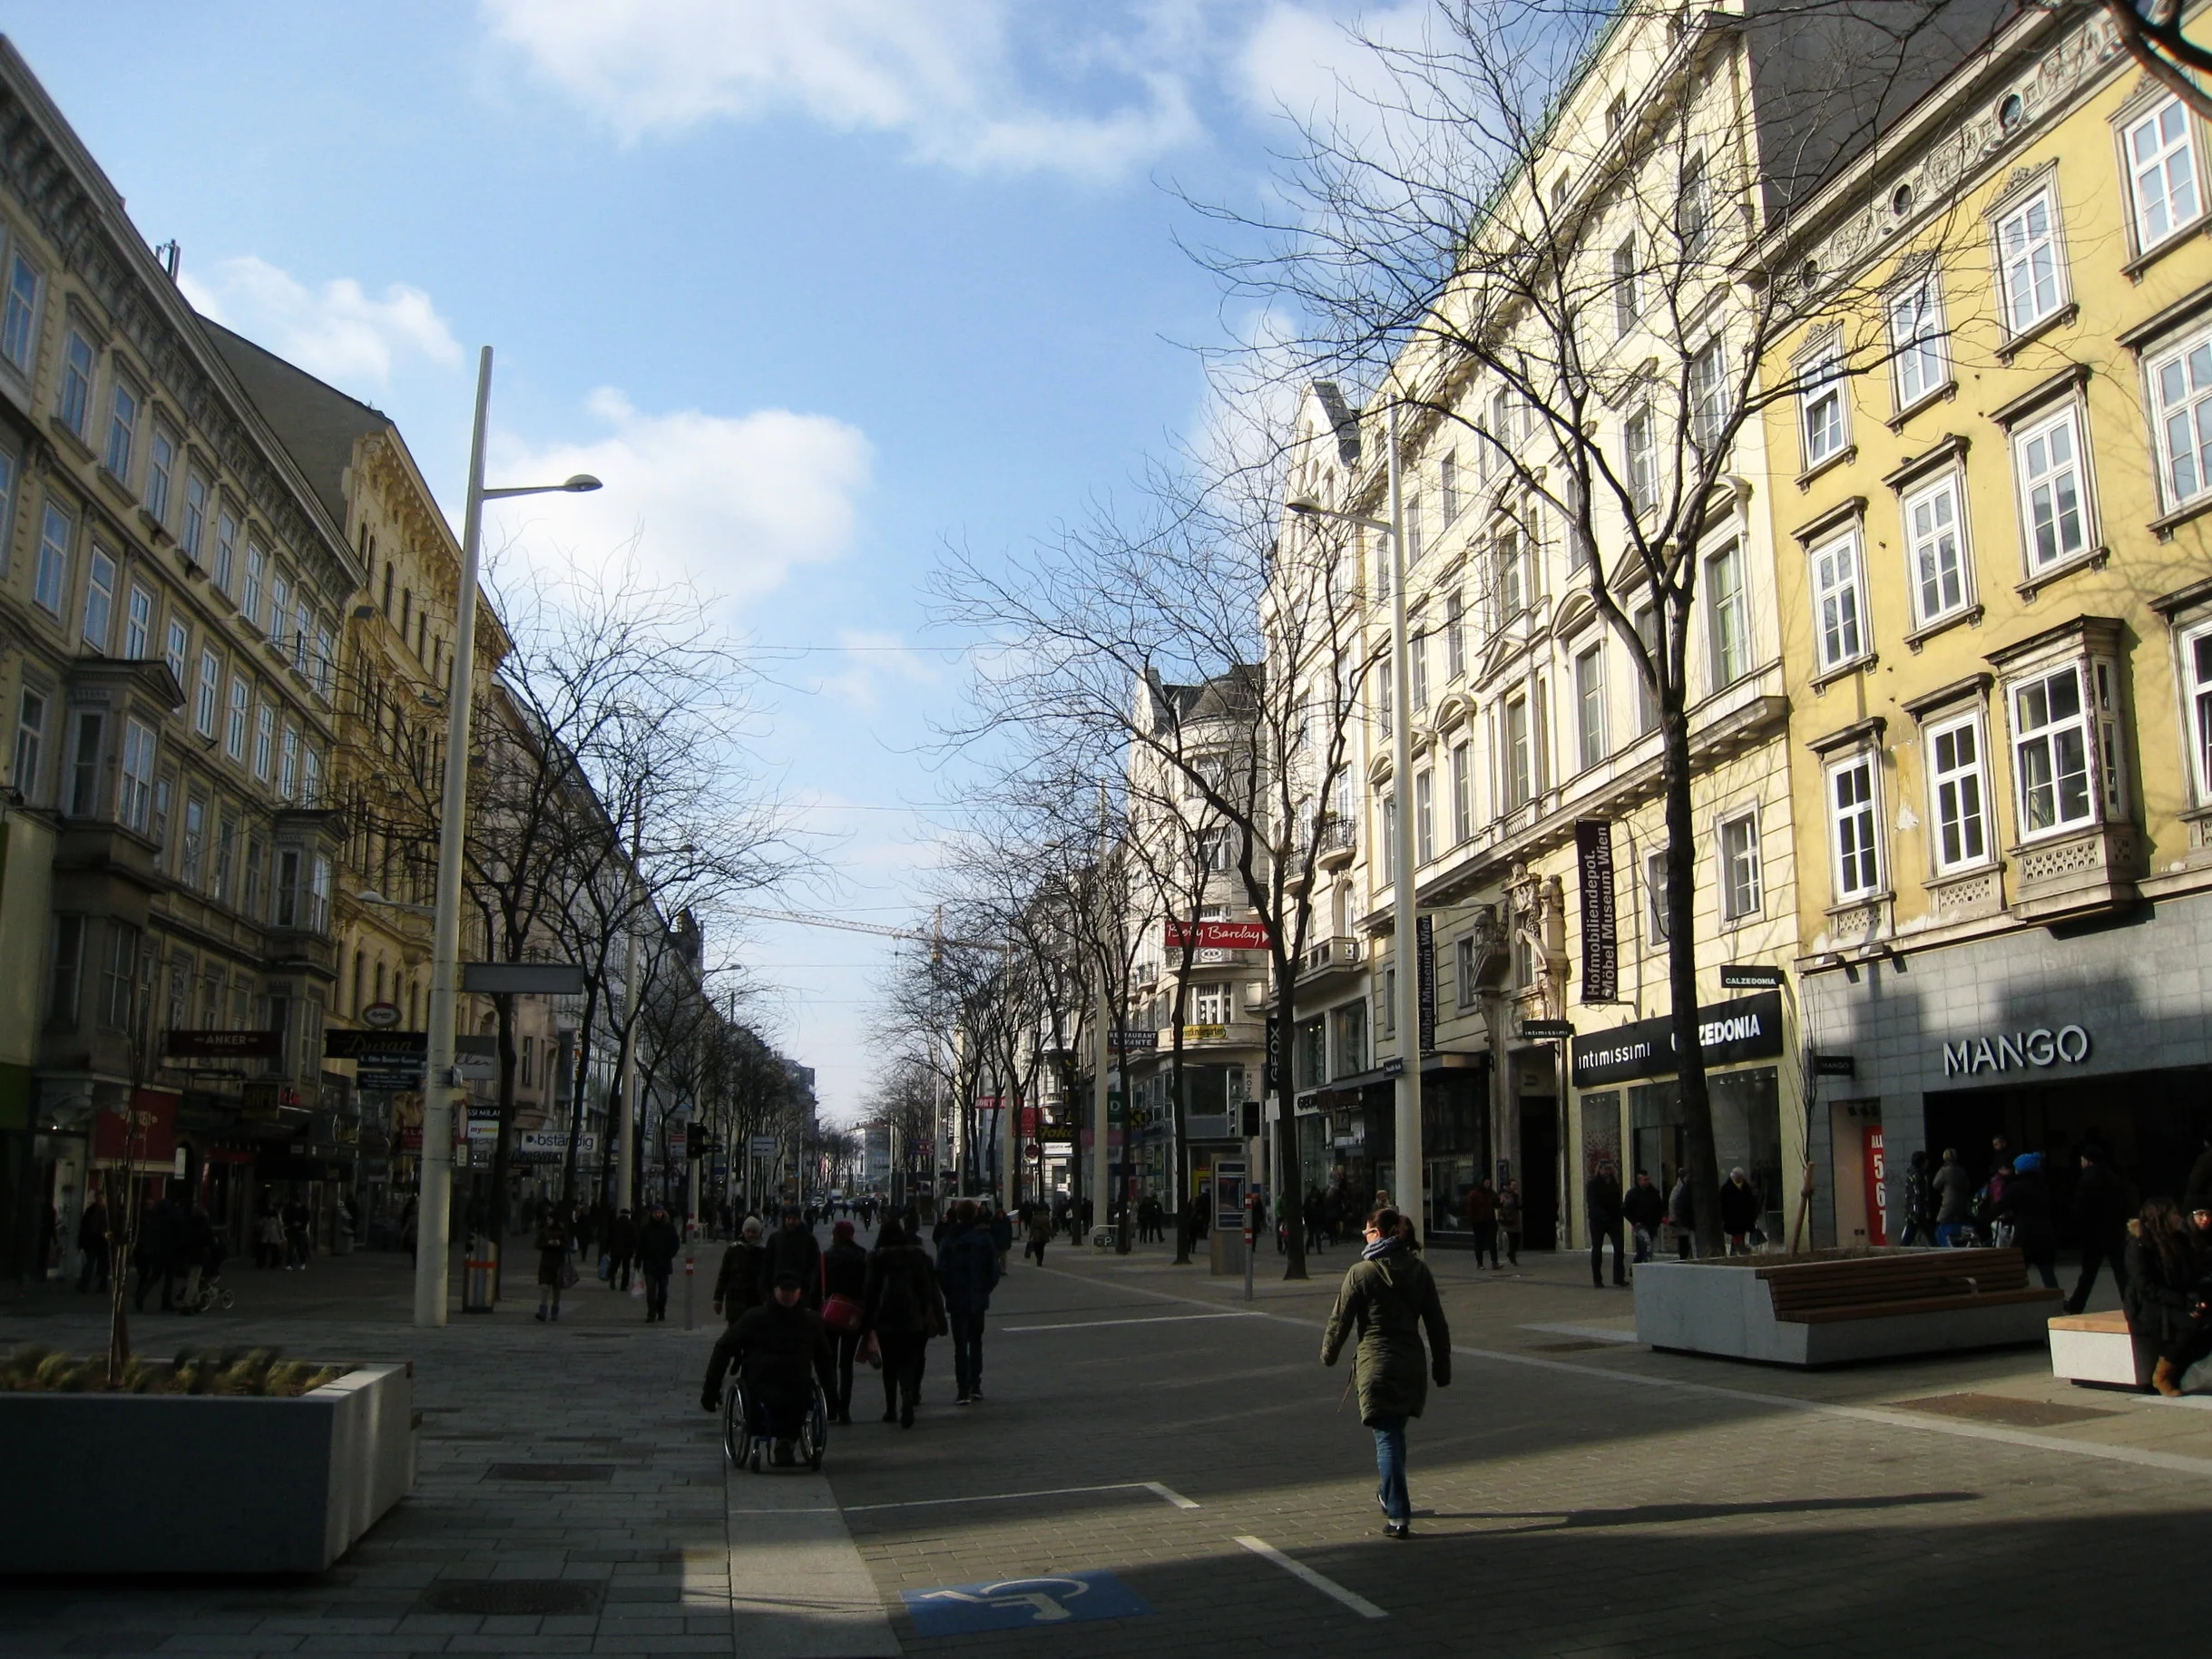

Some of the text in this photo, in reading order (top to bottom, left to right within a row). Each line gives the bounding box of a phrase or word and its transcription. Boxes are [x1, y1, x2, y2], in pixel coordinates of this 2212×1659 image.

[1585, 850, 1600, 996] Hofmobiliendepot.
[1598, 826, 1615, 997] Möbel Museum Wien
[1208, 925, 1259, 948] Barclay
[1421, 916, 1431, 946] Wien
[1422, 950, 1433, 1003] Museum
[1725, 977, 1776, 986] CALZEDONIA
[205, 1035, 247, 1045] ANKER
[1671, 1014, 1761, 1051] ZEDONIA
[1943, 1024, 2089, 1077] MANGO
[1270, 1026, 1279, 1082] GEOX
[1578, 1041, 1650, 1070] intimissimi
